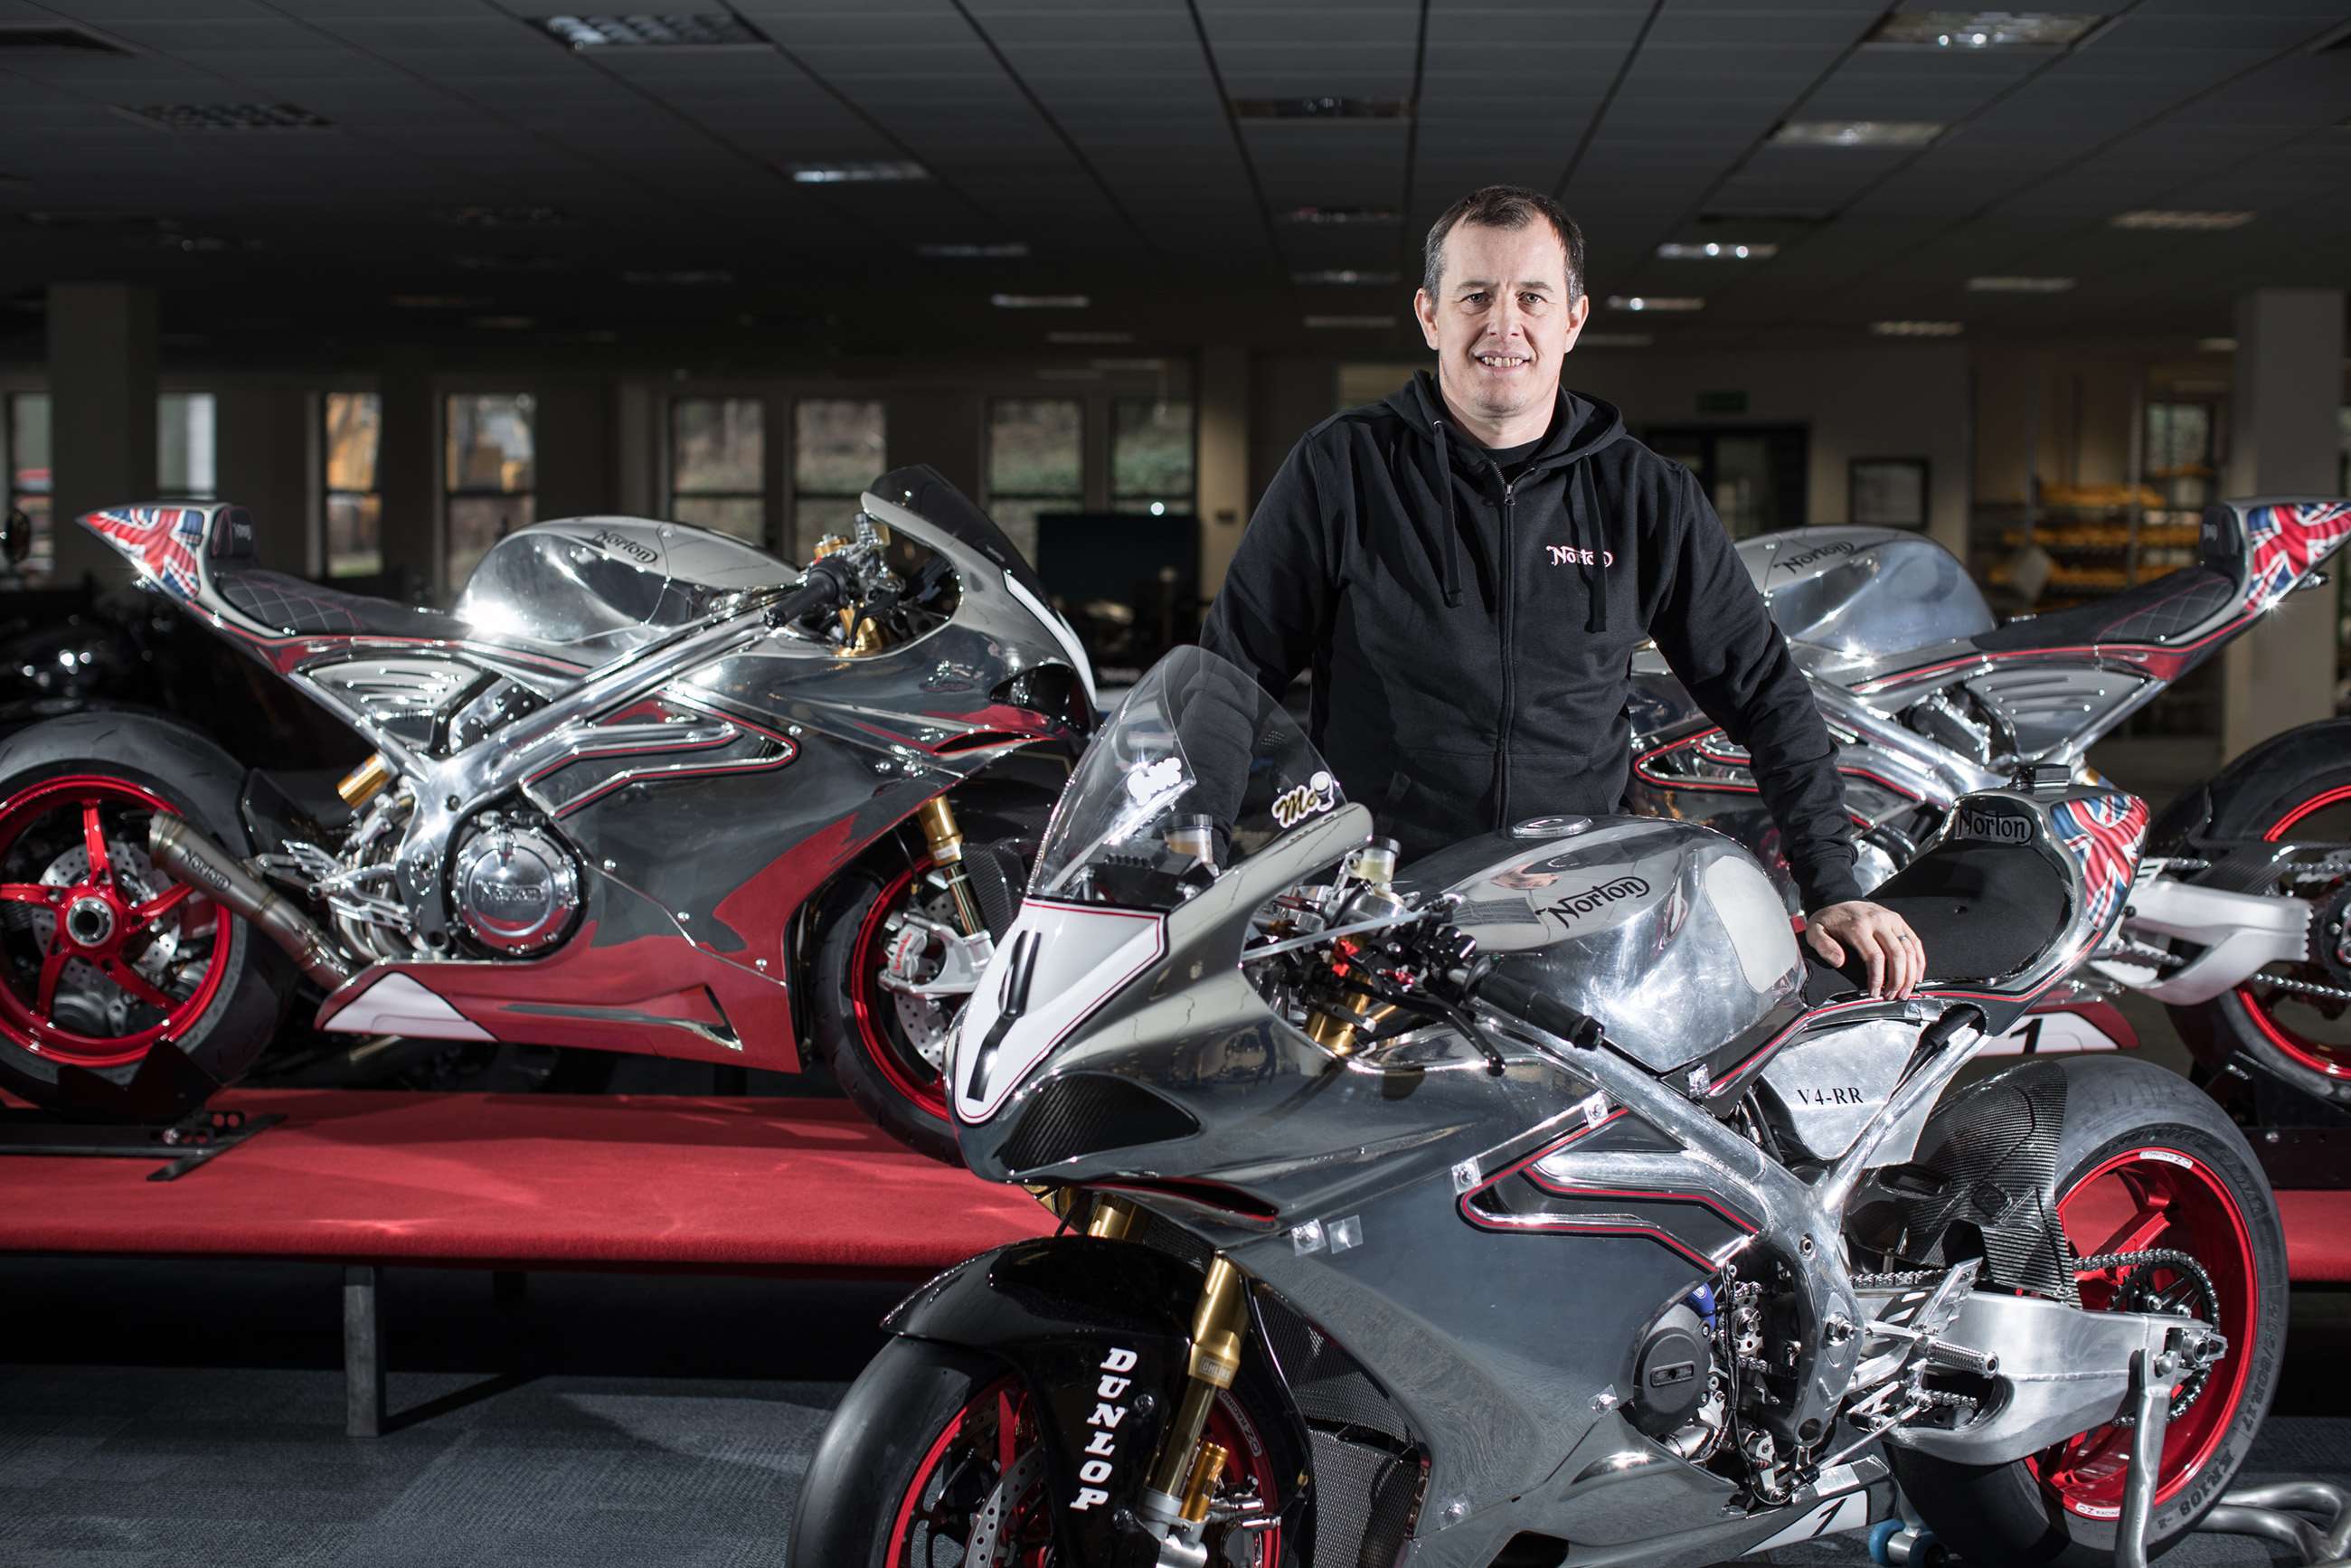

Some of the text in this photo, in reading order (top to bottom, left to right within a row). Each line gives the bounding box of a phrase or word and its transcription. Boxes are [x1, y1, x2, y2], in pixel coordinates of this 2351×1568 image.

[1955, 808, 2035, 844] Norton
[1535, 876, 1650, 929] Norton
[2009, 1018, 2044, 1055] 1
[1797, 1087, 1864, 1105] V4-RR
[1070, 1347, 1138, 1511] DUNLOP
[1811, 1497, 1847, 1537] 1
